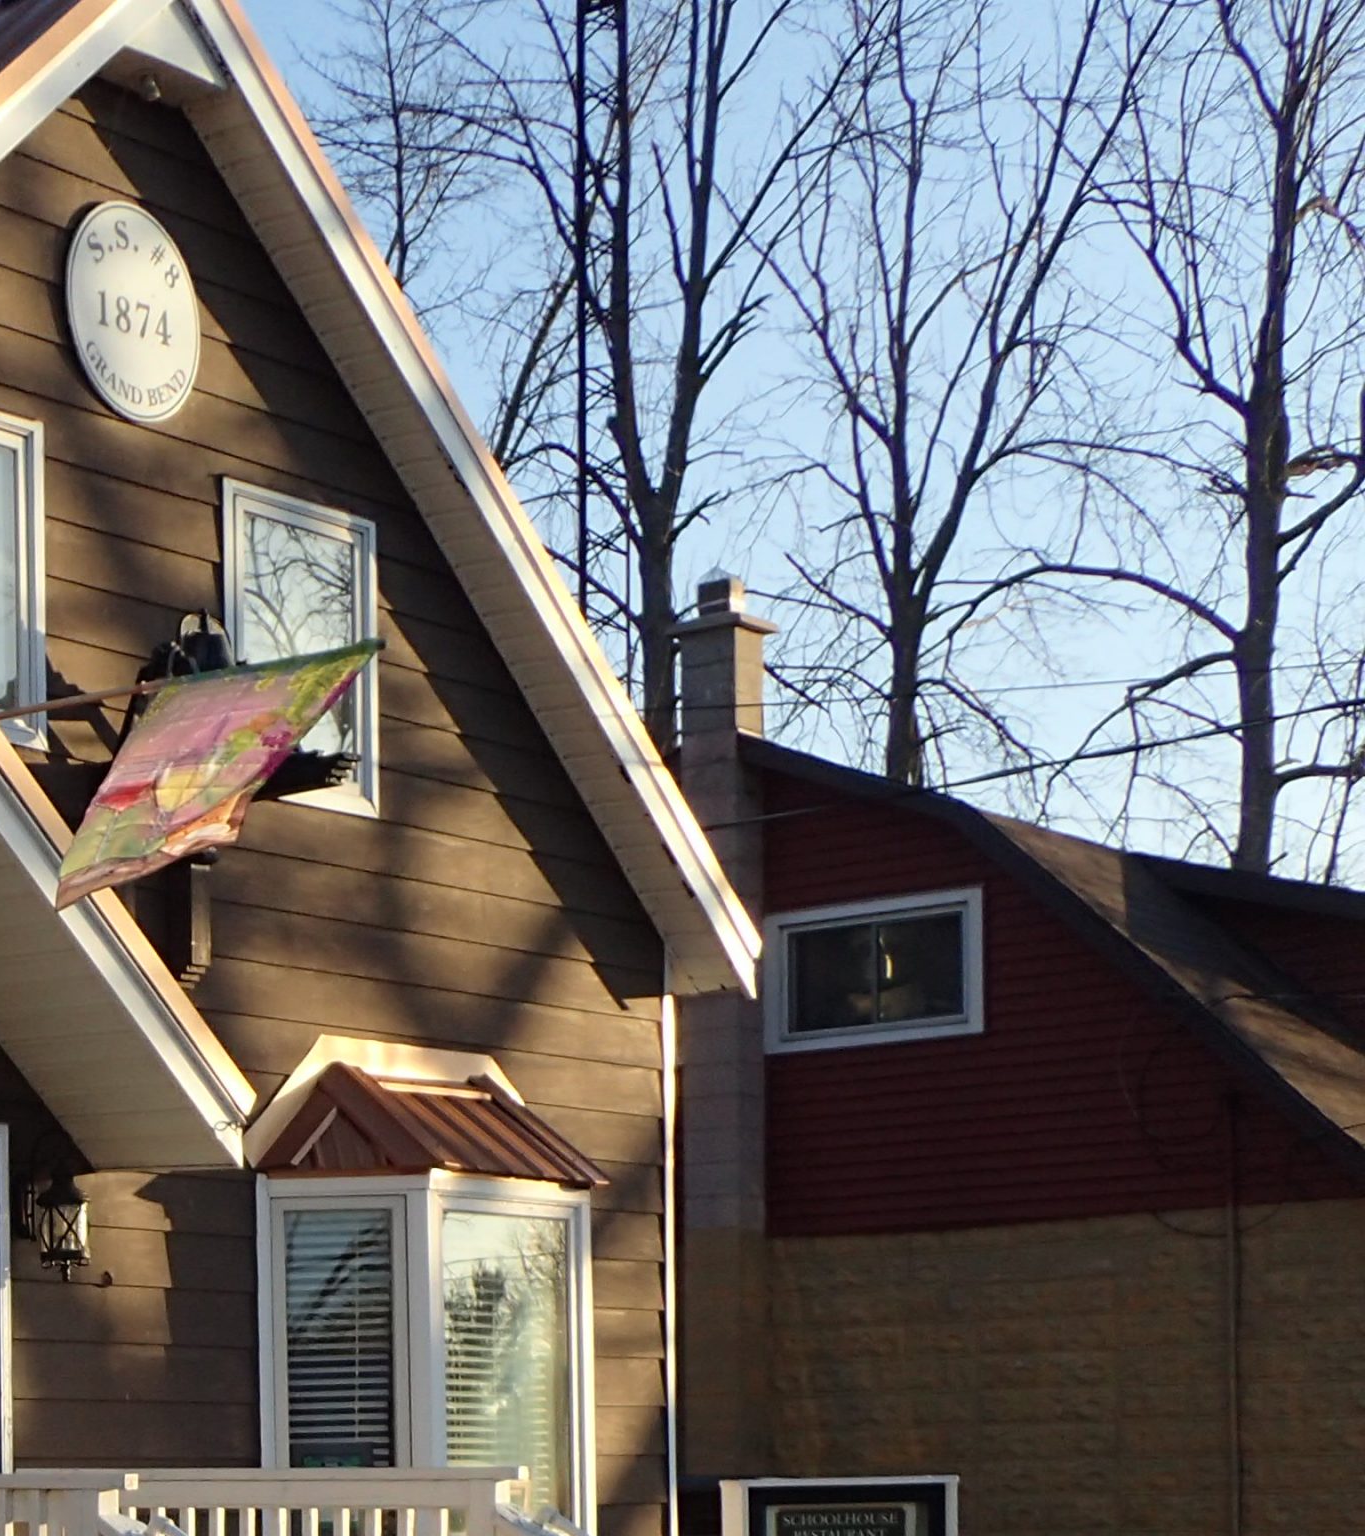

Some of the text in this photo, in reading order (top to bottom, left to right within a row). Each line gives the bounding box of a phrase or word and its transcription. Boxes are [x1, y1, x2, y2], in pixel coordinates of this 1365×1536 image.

[86, 220, 139, 263] S.S.
[97, 290, 172, 347] 1874
[86, 341, 186, 407] GRAND BEND
[782, 1512, 898, 1526] SCHOOLHOUSE
